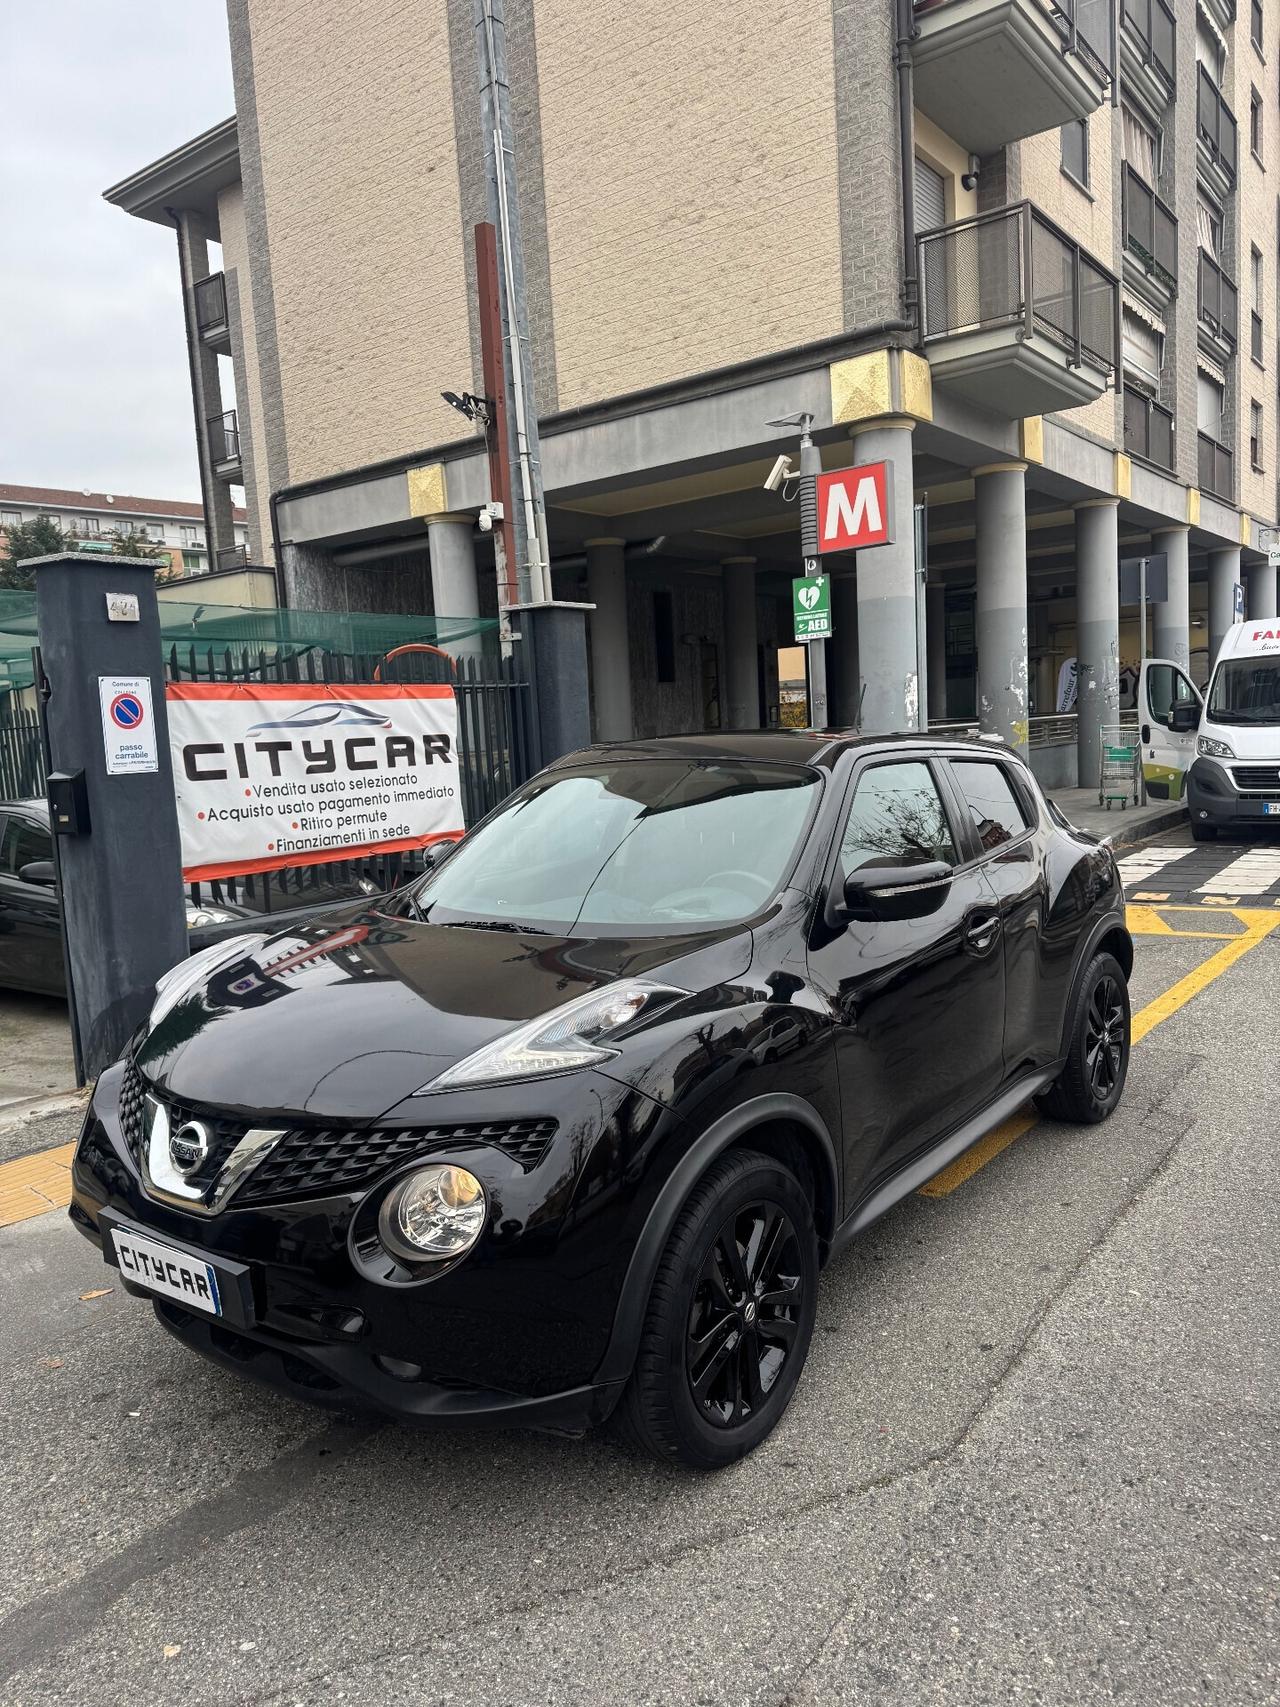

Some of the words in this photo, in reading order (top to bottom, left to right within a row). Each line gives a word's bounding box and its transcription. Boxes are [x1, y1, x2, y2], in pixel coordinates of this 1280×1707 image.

[824, 476, 883, 540] M
[1236, 588, 1243, 610] P
[807, 619, 828, 632] AED
[115, 751, 149, 760] carrabile
[119, 744, 143, 752] passo
[183, 734, 452, 782] CITYCAR
[253, 782, 306, 798] Vendita
[311, 781, 346, 795] usato
[349, 773, 418, 790] selezionato
[207, 803, 273, 823] Acquisto
[278, 800, 314, 815] usato
[319, 791, 391, 814] pagamento
[394, 786, 454, 803] immediato
[301, 817, 333, 832] Ritiro
[336, 810, 387, 830] permute
[276, 831, 366, 852] Finanziamenti
[368, 830, 380, 841] in
[382, 824, 410, 838] sede
[119, 1245, 211, 1300] CITYCAR
